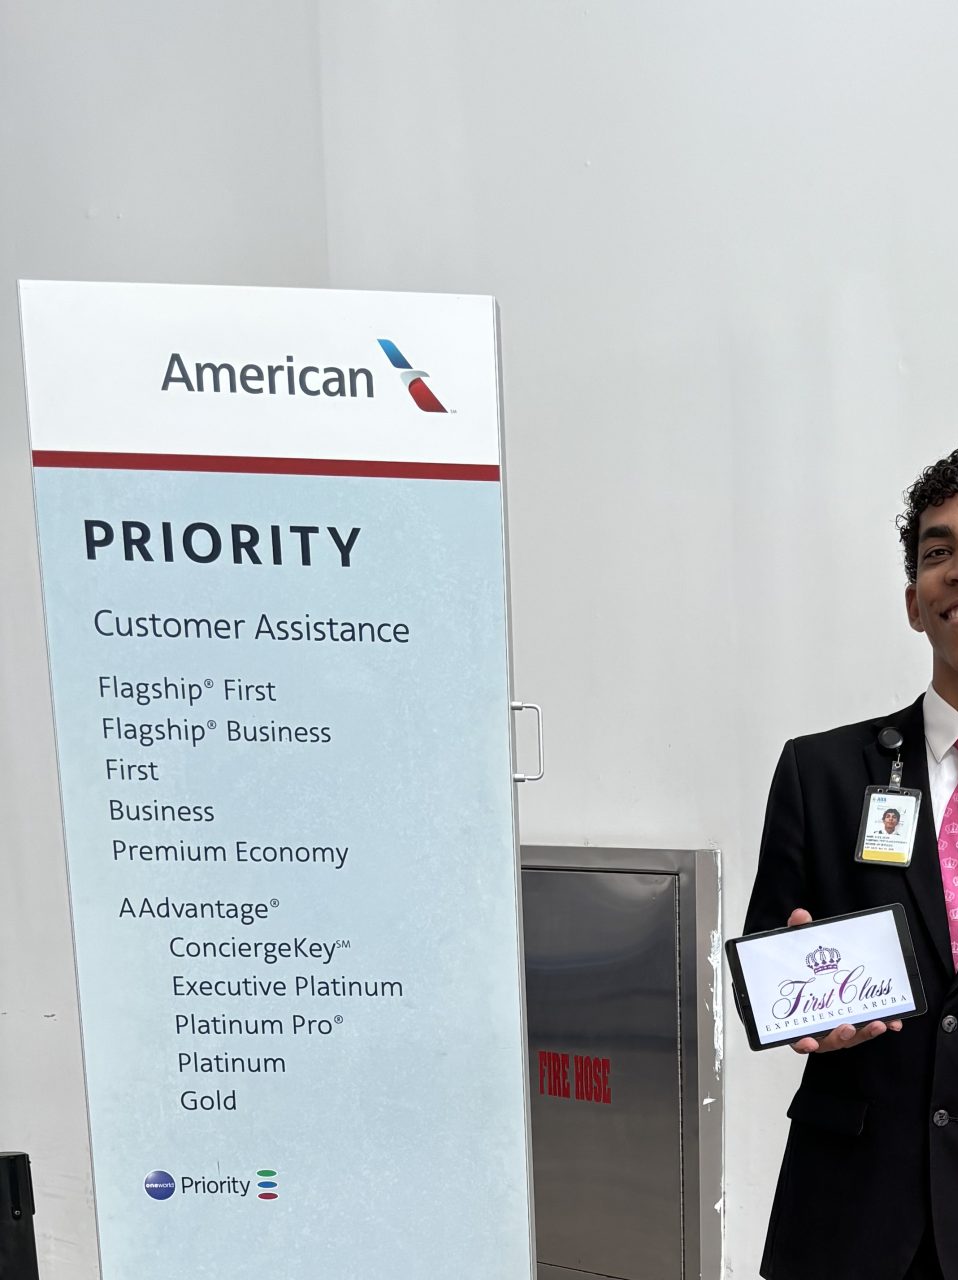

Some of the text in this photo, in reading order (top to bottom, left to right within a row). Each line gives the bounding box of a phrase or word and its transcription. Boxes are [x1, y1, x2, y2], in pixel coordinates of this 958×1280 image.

[161, 352, 375, 399] American
[84, 519, 362, 568] PRIORITY
[94, 609, 410, 644] Customer Assistance
[224, 678, 277, 702] First
[227, 719, 332, 744] Business
[106, 757, 160, 782] First
[110, 799, 215, 823] Business
[113, 839, 349, 870] Premium Economy
[173, 975, 403, 997] Executive Platinum
[772, 965, 892, 1020] First Class
[175, 1013, 284, 1035] Platinum
[765, 994, 907, 1032] EXPERIENCE ARUBA
[178, 1051, 286, 1073] Platinum
[538, 1051, 612, 1105] FIRE HOSE
[181, 1089, 237, 1111] Gold
[181, 1176, 251, 1197] Priority
